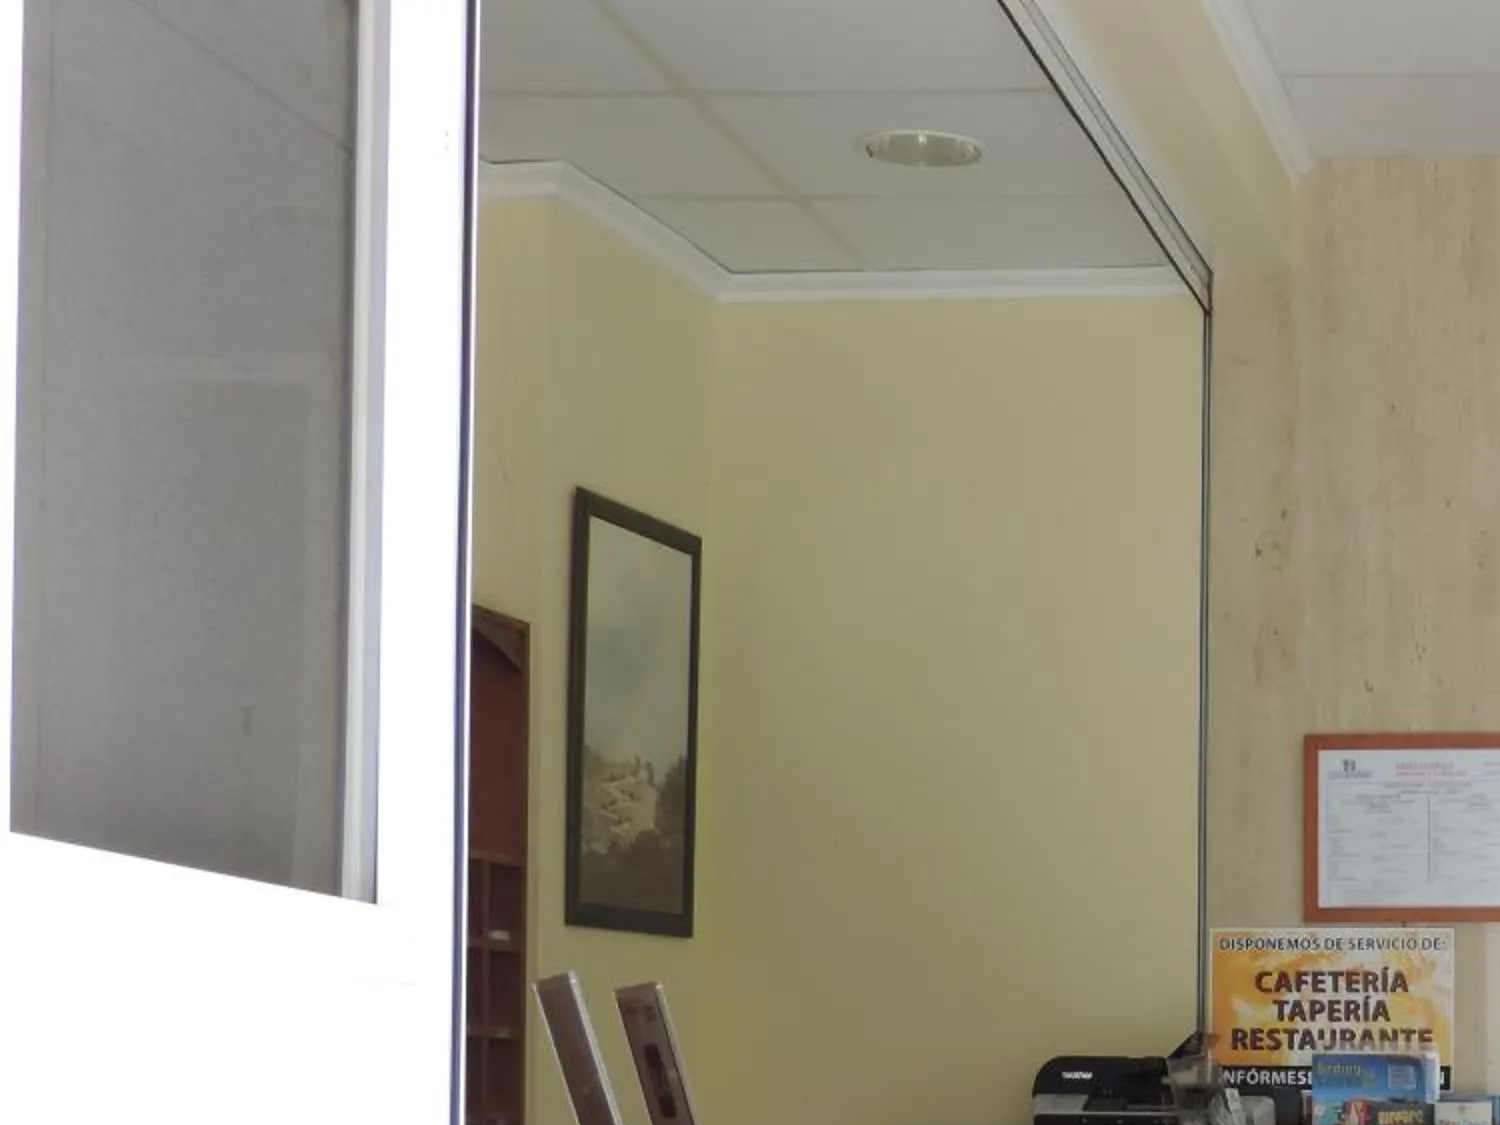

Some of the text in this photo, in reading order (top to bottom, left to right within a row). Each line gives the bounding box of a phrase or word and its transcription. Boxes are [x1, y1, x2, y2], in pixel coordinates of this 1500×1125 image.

[1219, 937, 1321, 951] DISPONEMOS
[1324, 937, 1343, 950] DE
[1349, 937, 1417, 951] SERVICIO
[1254, 965, 1409, 993] CAFETERÍA
[1272, 995, 1391, 1022] TAPERÍA
[1230, 1027, 1434, 1050] RESTAURANTE
[1221, 1067, 1313, 1085] NFÓRMES
